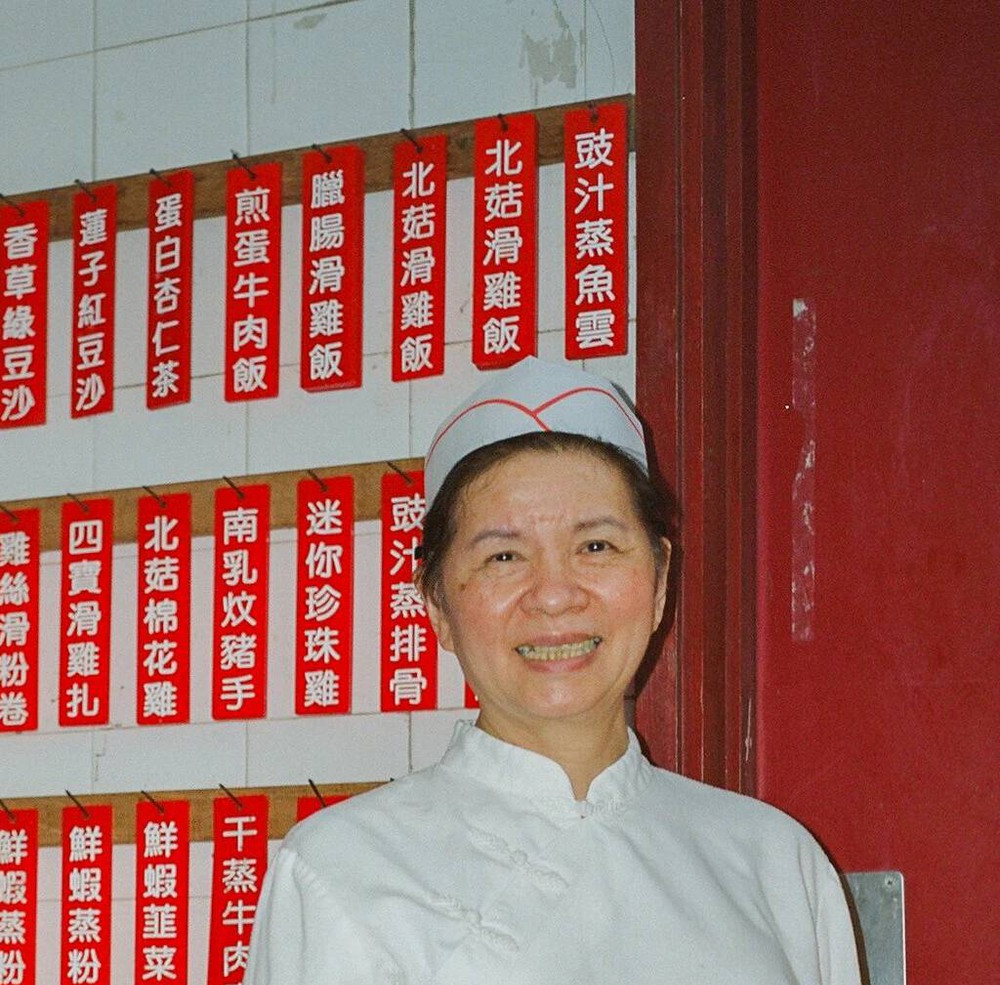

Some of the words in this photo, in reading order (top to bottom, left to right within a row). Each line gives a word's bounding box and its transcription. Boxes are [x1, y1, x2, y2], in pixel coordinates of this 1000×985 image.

[1, 224, 37, 420] 香草綠豆沙
[76, 209, 107, 410] 蓮子紅豆沙
[152, 194, 182, 397] 蛋白杏仁茶
[233, 187, 270, 392] 煎蛋牛肉飯
[309, 170, 344, 380] 臘腸滑雞飯
[400, 162, 435, 372] 北菇滑雞飯
[483, 139, 523, 354] 北菇滑雞飯
[575, 128, 615, 348] 豉汁蒸魚雲
[67, 520, 102, 717] 四寶滑雞扎
[143, 516, 179, 717] 北菇棉花雞
[221, 507, 258, 710] 南乳炆豬手
[304, 499, 342, 706] 迷你珍珠雞
